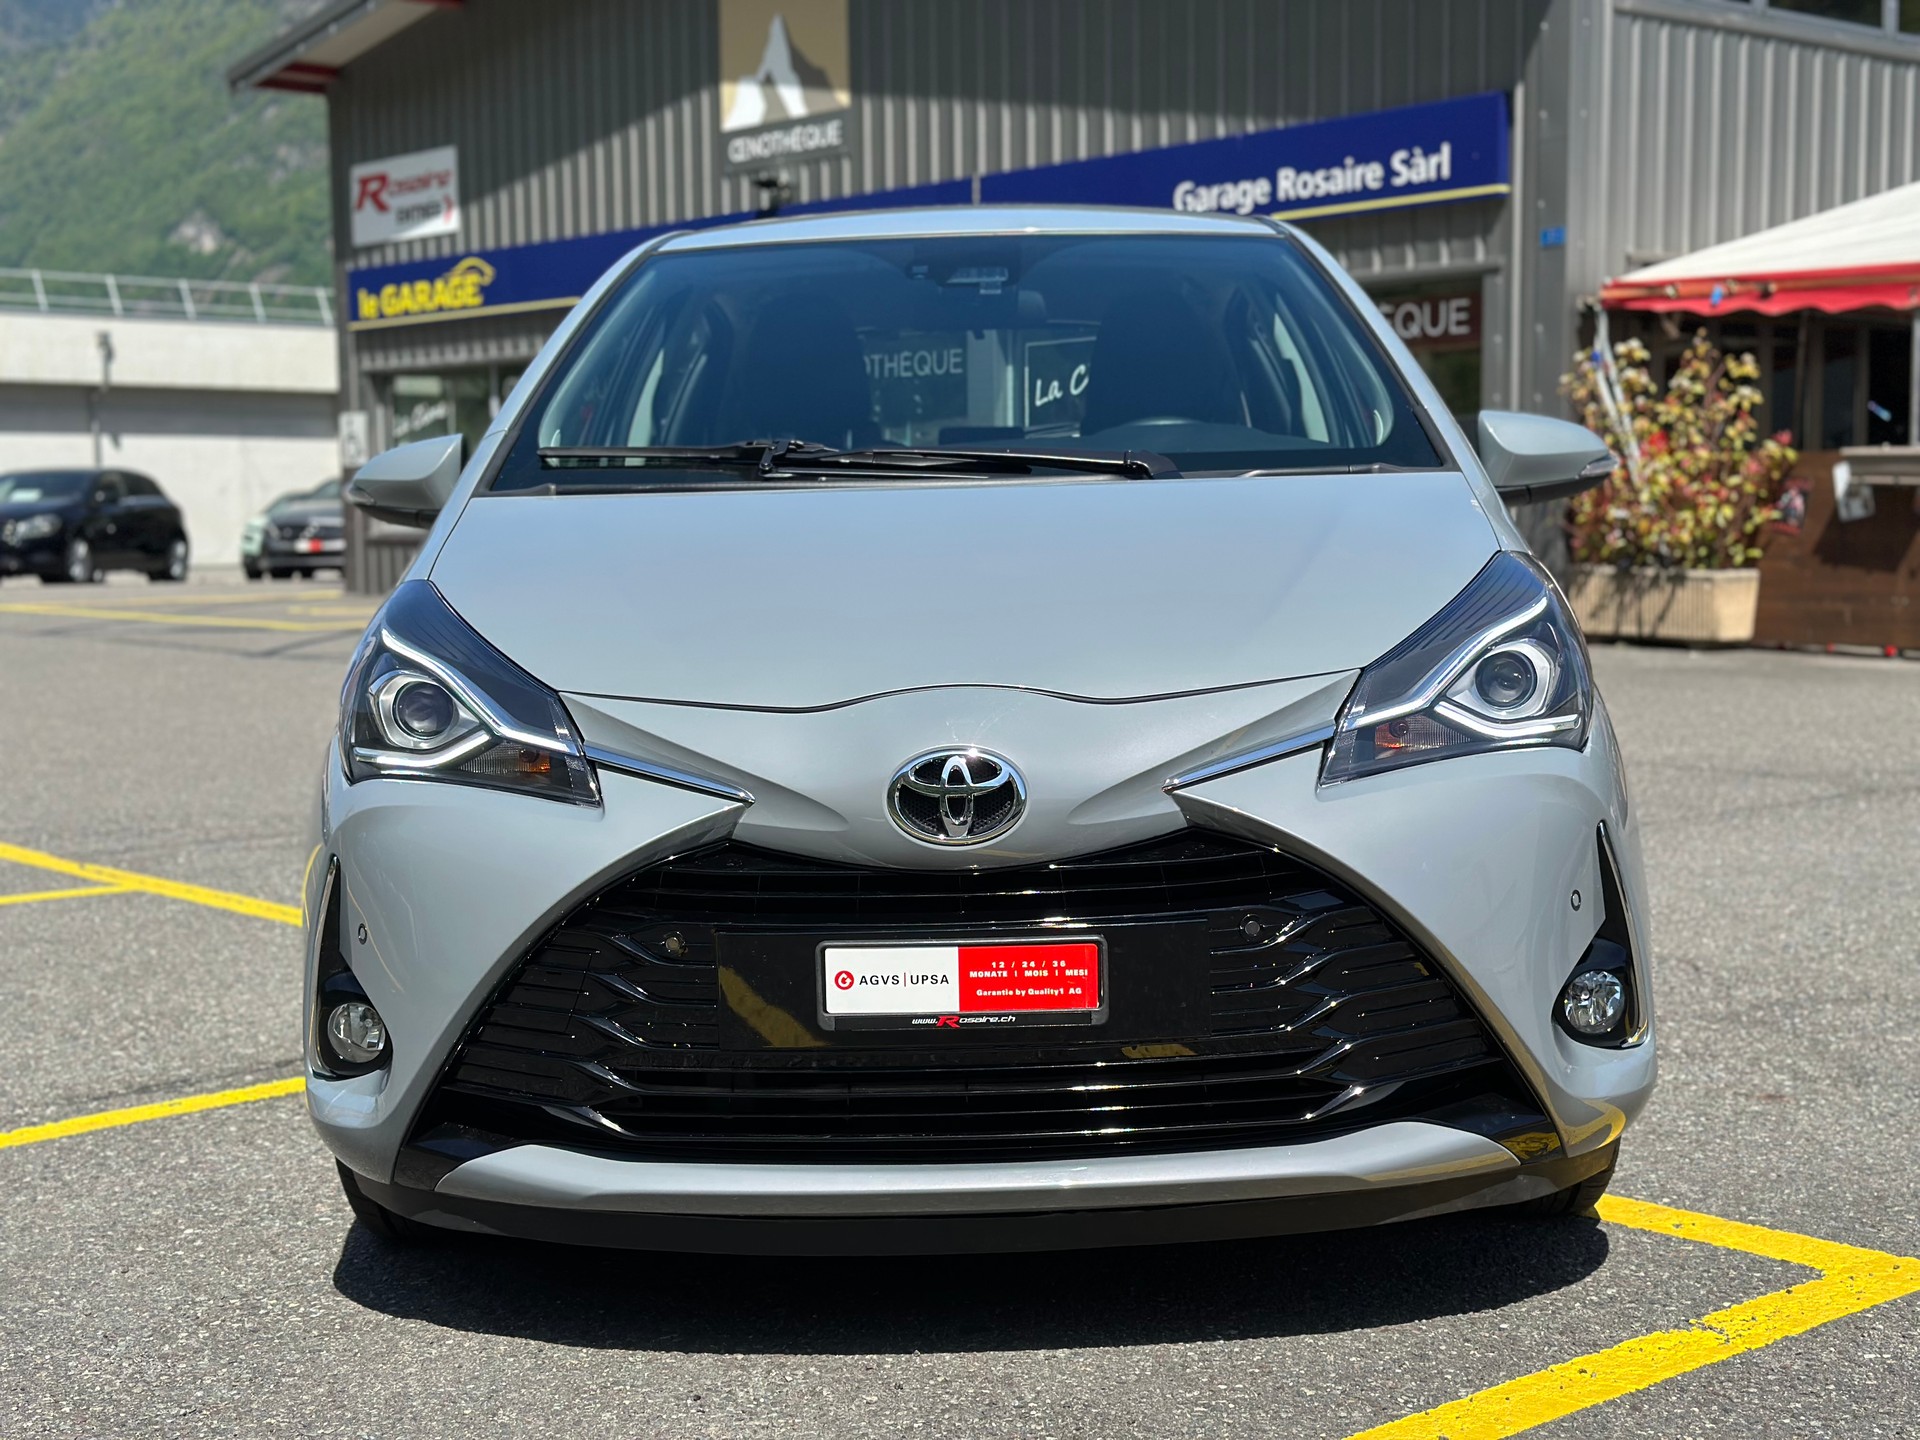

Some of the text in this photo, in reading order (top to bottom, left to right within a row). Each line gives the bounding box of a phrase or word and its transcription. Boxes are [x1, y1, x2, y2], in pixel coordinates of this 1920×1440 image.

[1173, 141, 1451, 215] Garage Rosaire Sàrl
[380, 273, 484, 317] GARAGE
[1034, 379, 1063, 407] La
[992, 961, 1005, 969] 12
[1022, 960, 1036, 968] 24
[1052, 960, 1067, 968] 36
[859, 974, 950, 986] AGVS UPSA
[969, 970, 1008, 978] MONATE
[976, 987, 1083, 997] Garantie by Quality1 AG
[911, 1015, 1016, 1029] www.Rosaire.ch
